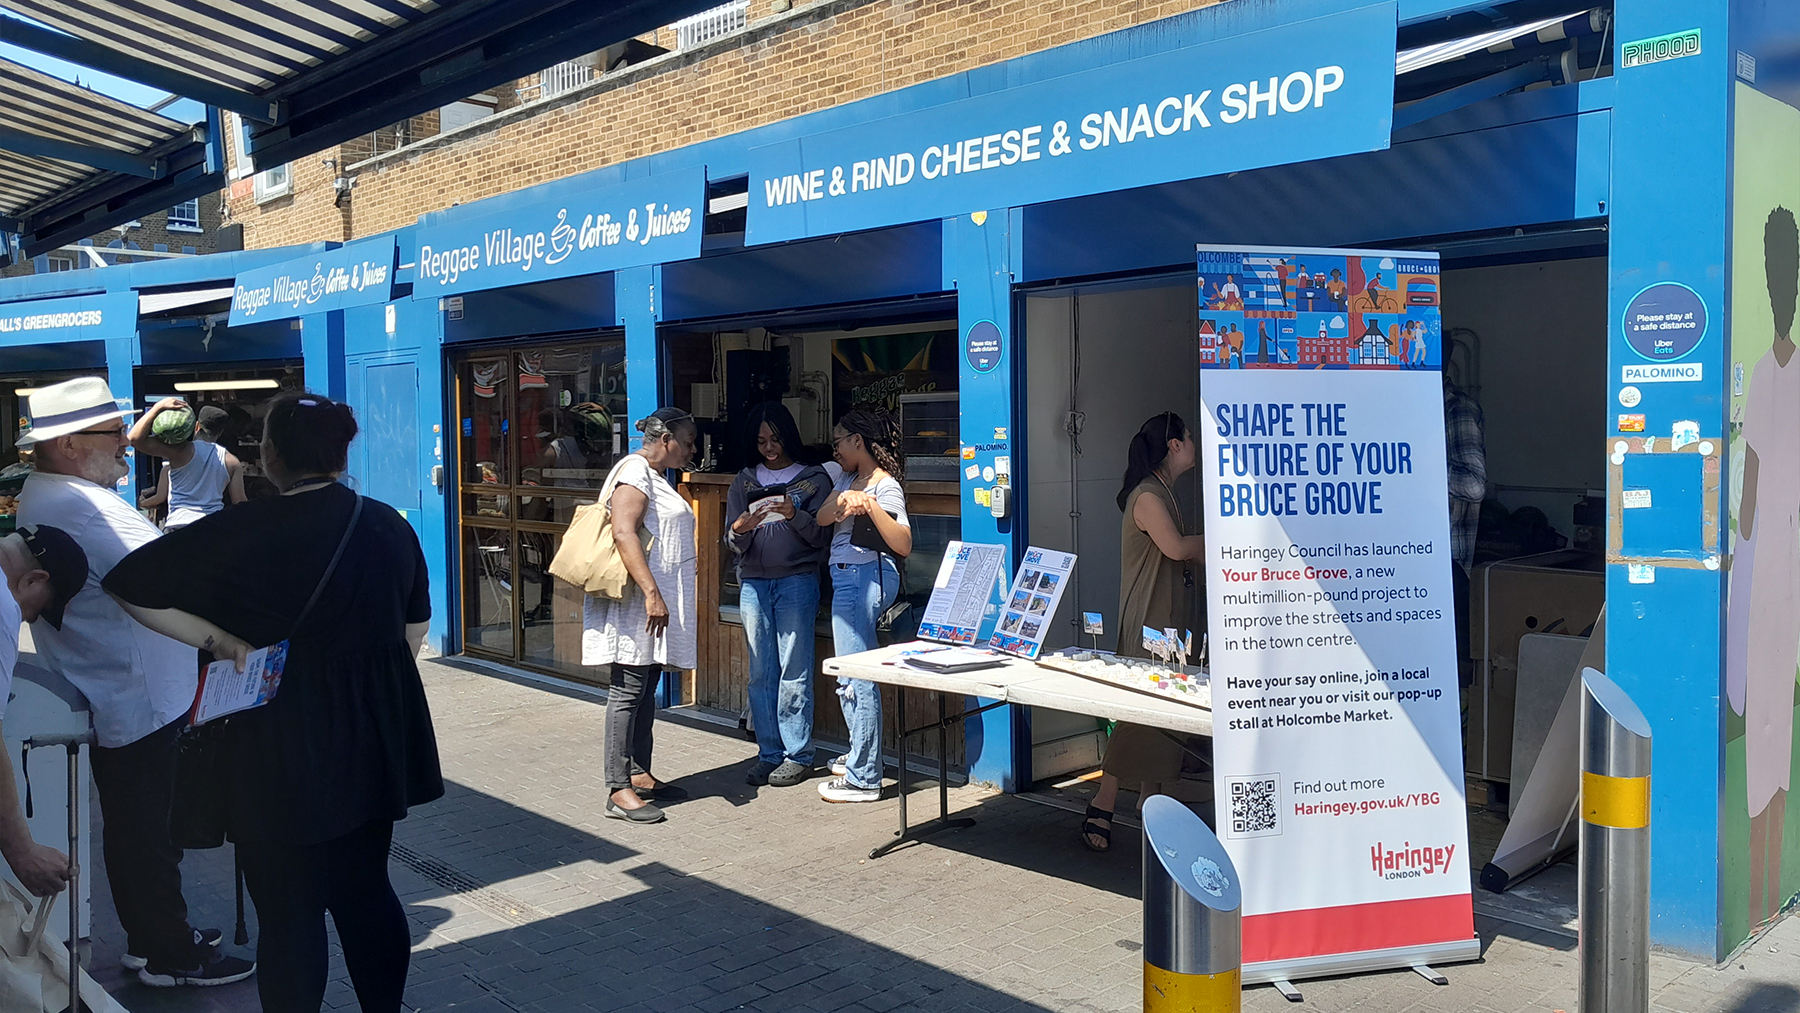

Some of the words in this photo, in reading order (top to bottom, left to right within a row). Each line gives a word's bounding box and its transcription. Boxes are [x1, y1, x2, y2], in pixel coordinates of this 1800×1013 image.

[1624, 33, 1699, 67] PHOOD
[765, 169, 825, 207] WINE
[828, 166, 847, 197] &
[851, 152, 915, 193] RIND
[921, 125, 1042, 180] CHEESE
[1048, 120, 1072, 157] &
[1079, 89, 1212, 150] SNACK
[1219, 65, 1345, 124] SHOP
[579, 213, 621, 251] Coffee
[625, 208, 639, 241] &
[640, 203, 692, 246] Juices
[420, 245, 479, 285] Reggae
[484, 228, 545, 271] Village
[325, 268, 349, 294] Coffee
[351, 265, 359, 289] &
[359, 261, 387, 292] Juices
[1397, 264, 1419, 273] BRUCE
[234, 285, 271, 316] Reggae
[273, 275, 308, 308] Village
[23, 309, 102, 330] GREENGROCERS
[1636, 314, 1664, 322] Please
[1665, 313, 1683, 321] stay
[1640, 323, 1658, 331] safe
[1659, 322, 1696, 330] distance
[1626, 367, 1699, 378] PALOMINO.
[1217, 403, 1295, 437] SHAPE
[1301, 403, 1347, 436] THE
[1218, 443, 1309, 477] FUTURE
[1316, 443, 1344, 476] OF
[1350, 442, 1413, 475] YOUR
[1219, 483, 1298, 517] BRUCE
[1305, 481, 1383, 515] GROVE
[1221, 545, 1286, 563] Haringey
[1288, 543, 1341, 558] Council
[1344, 543, 1369, 557] has
[1372, 541, 1433, 556] launched
[1221, 568, 1258, 583] Your
[1261, 567, 1301, 581] Bruce
[1304, 566, 1352, 581] Grove,
[1355, 569, 1363, 579] a
[1366, 566, 1396, 578] new
[1223, 587, 1358, 606] multimillion-pound
[1362, 586, 1411, 603] project
[1413, 585, 1428, 598] to
[1224, 614, 1283, 630] improve
[1285, 612, 1309, 626] the
[1312, 610, 1363, 625] streets
[1366, 608, 1392, 623] and
[1395, 608, 1442, 624] spaces
[1225, 637, 1239, 651] in
[1242, 636, 1267, 650] the
[1269, 635, 1304, 649] town
[1307, 633, 1357, 647] centre.
[1227, 676, 1263, 690] Have
[1265, 676, 1292, 691] your
[1295, 675, 1317, 690] say
[1319, 671, 1363, 685] online,
[1364, 669, 1389, 685] join
[1391, 670, 1399, 681] a
[1401, 667, 1430, 680] local
[1228, 697, 1267, 710] event
[1269, 695, 1297, 707] near
[1299, 694, 1323, 709] you
[1325, 693, 1340, 704] or
[1342, 690, 1370, 703] visit
[1373, 690, 1395, 701] our
[1397, 688, 1442, 703] pop-up
[1229, 717, 1259, 730] stall
[1261, 716, 1274, 728] at
[1276, 712, 1341, 728] Holcombe
[1344, 709, 1393, 723] Market.
[1293, 781, 1321, 794] Find
[1324, 780, 1347, 792] out
[1350, 778, 1385, 791] more
[1294, 791, 1440, 817] Haringey.gov.uk/YBG
[1370, 841, 1456, 878] Haringey
[1385, 870, 1421, 880] LONDON
